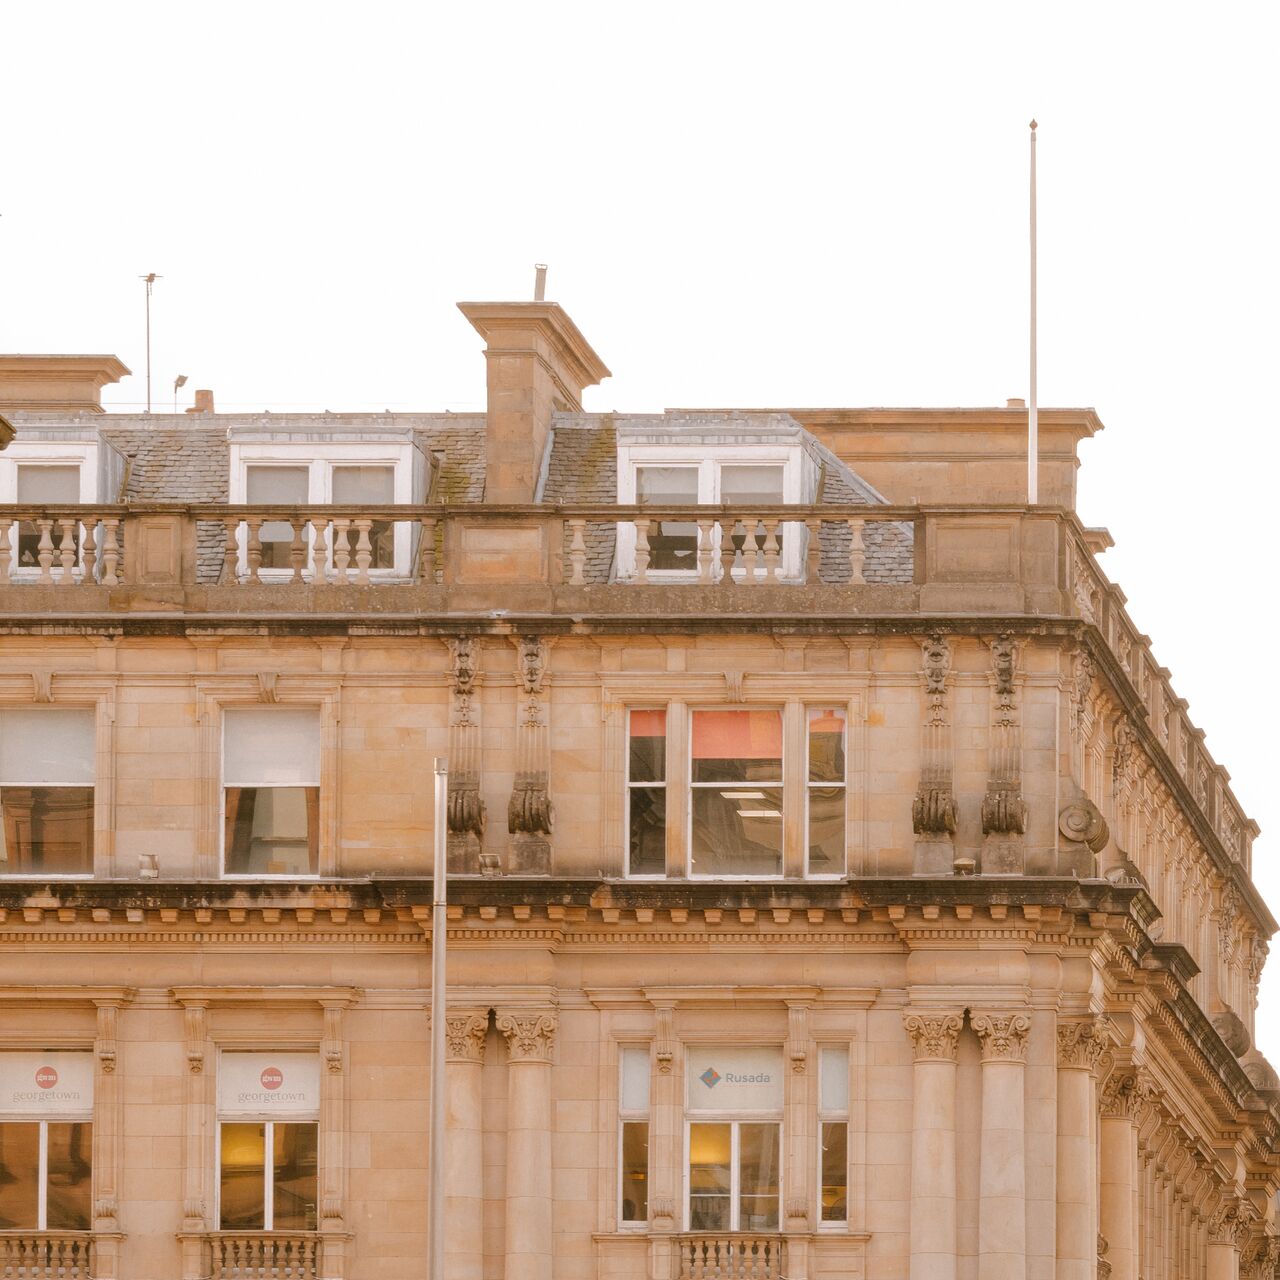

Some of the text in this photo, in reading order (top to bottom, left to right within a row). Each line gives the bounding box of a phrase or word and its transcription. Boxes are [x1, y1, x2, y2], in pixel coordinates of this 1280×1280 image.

[726, 1073, 770, 1083] Rusada
[13, 1091, 80, 1103] georgetown
[238, 1092, 305, 1104] georgetown
